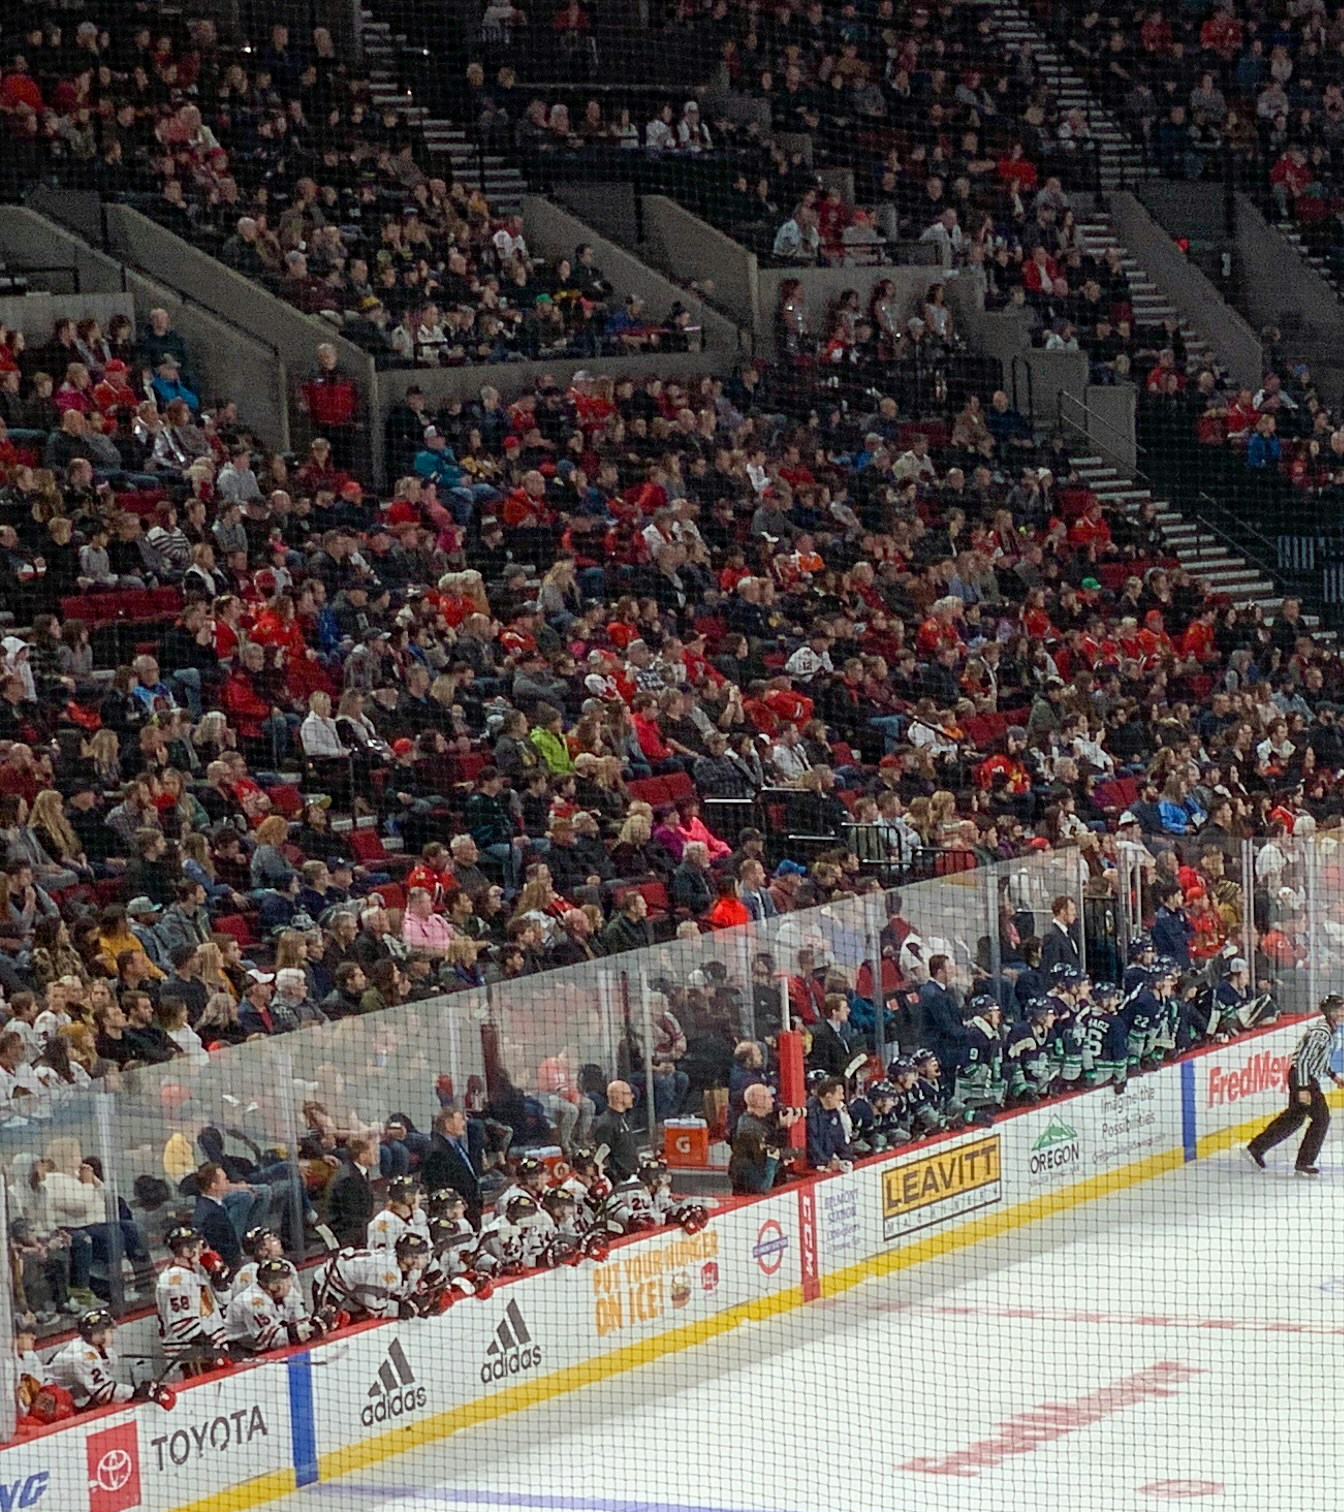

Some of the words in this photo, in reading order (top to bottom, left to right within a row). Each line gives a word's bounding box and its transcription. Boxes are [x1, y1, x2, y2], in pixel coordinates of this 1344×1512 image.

[1134, 1014, 1150, 1028] 22
[1207, 1049, 1292, 1109] FredMey
[886, 1144, 996, 1211] LEAVITT
[1030, 1142, 1080, 1174] OREGON
[593, 1262, 620, 1297] PUT
[624, 1250, 664, 1284] YOUR
[665, 1228, 720, 1271] HUNGER
[801, 1195, 816, 1277] CCM
[595, 1292, 623, 1338] ON
[629, 1277, 665, 1326] ICE!
[480, 1345, 542, 1384] adidas
[361, 1386, 428, 1427] adidas
[151, 1404, 268, 1471] TOYOTA
